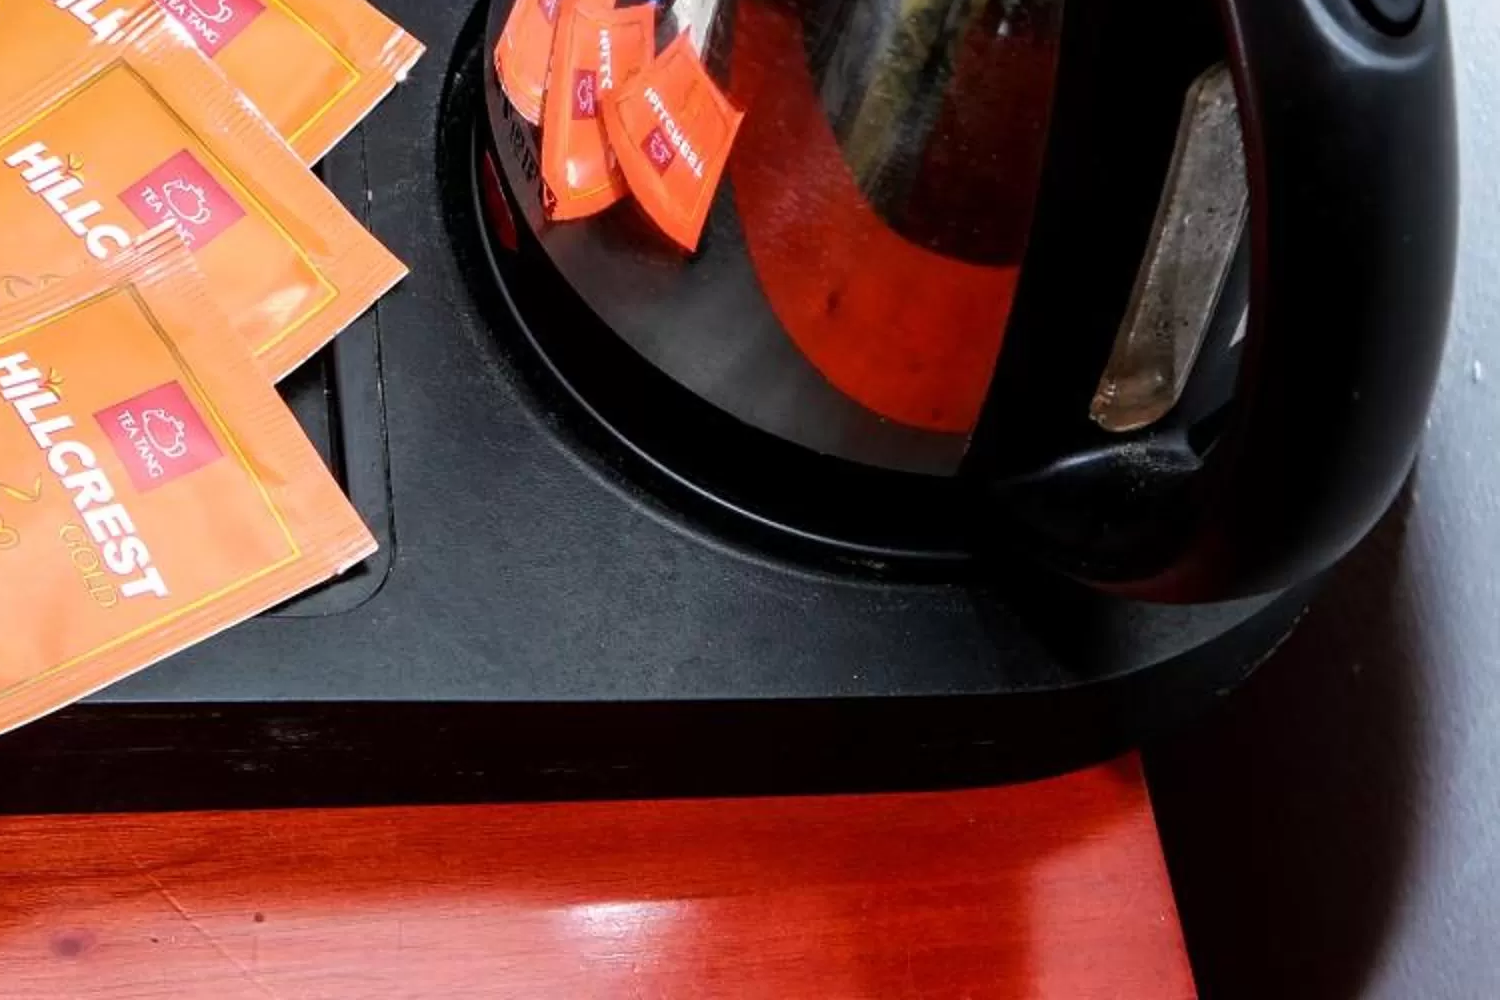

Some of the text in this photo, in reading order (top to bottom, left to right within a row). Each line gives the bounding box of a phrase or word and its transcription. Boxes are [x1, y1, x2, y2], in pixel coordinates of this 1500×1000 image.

[185, 10, 221, 45] TANG
[139, 185, 164, 216] TEA
[116, 408, 165, 482] TEA TANG
[57, 522, 122, 610] GOLD
